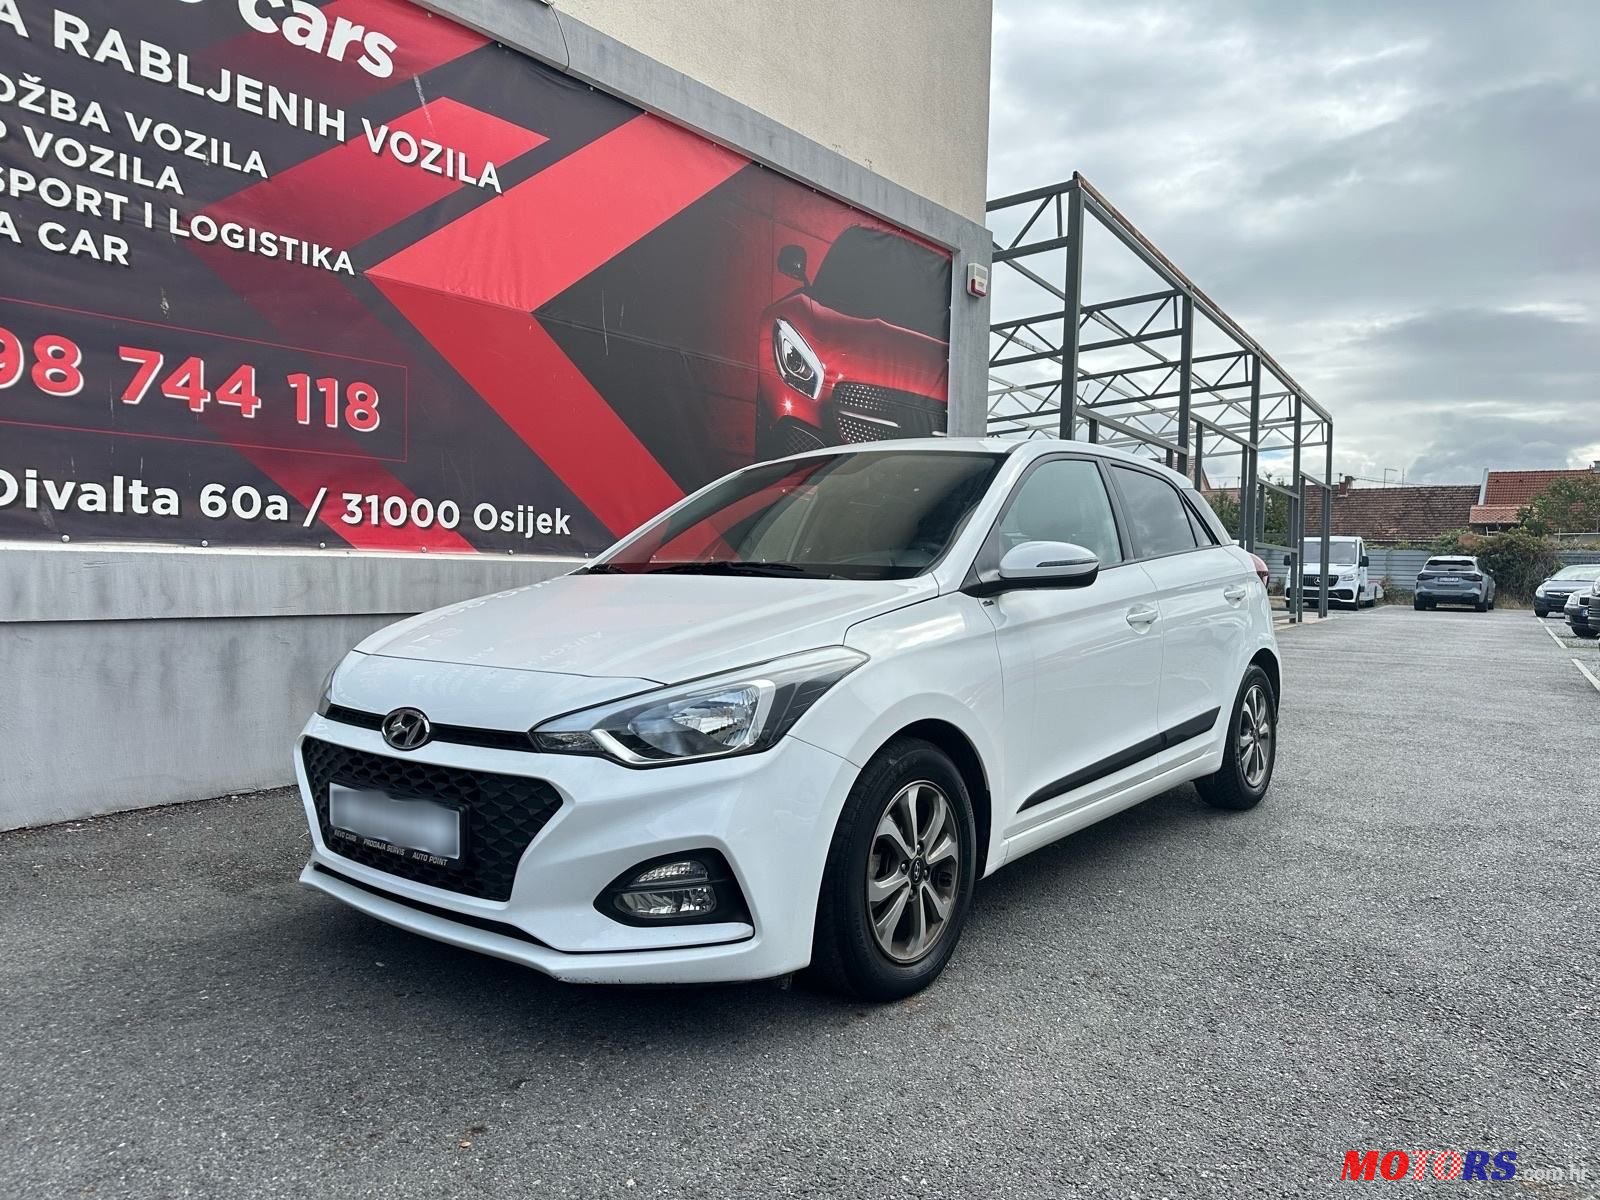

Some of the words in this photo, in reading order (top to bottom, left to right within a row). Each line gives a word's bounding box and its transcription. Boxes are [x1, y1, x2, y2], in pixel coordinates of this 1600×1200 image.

[238, 0, 397, 79] cars
[54, 9, 345, 143] RABLJENIH
[361, 118, 502, 194] VOZILA
[22, 125, 184, 196] VOZILA
[124, 111, 269, 179] VOZILA
[0, 166, 129, 222] PORT
[145, 202, 153, 229] I
[170, 208, 355, 276] LOGISTIKA
[38, 222, 129, 266] CAR
[118, 345, 262, 419] 744
[287, 373, 381, 432] 118
[200, 483, 288, 521] 60a
[303, 487, 328, 528] /
[341, 492, 460, 529] 31000
[473, 502, 571, 539] Osijek
[363, 838, 386, 850] PRODAJA
[412, 851, 428, 862] AUTO
[429, 855, 448, 866] POINT
